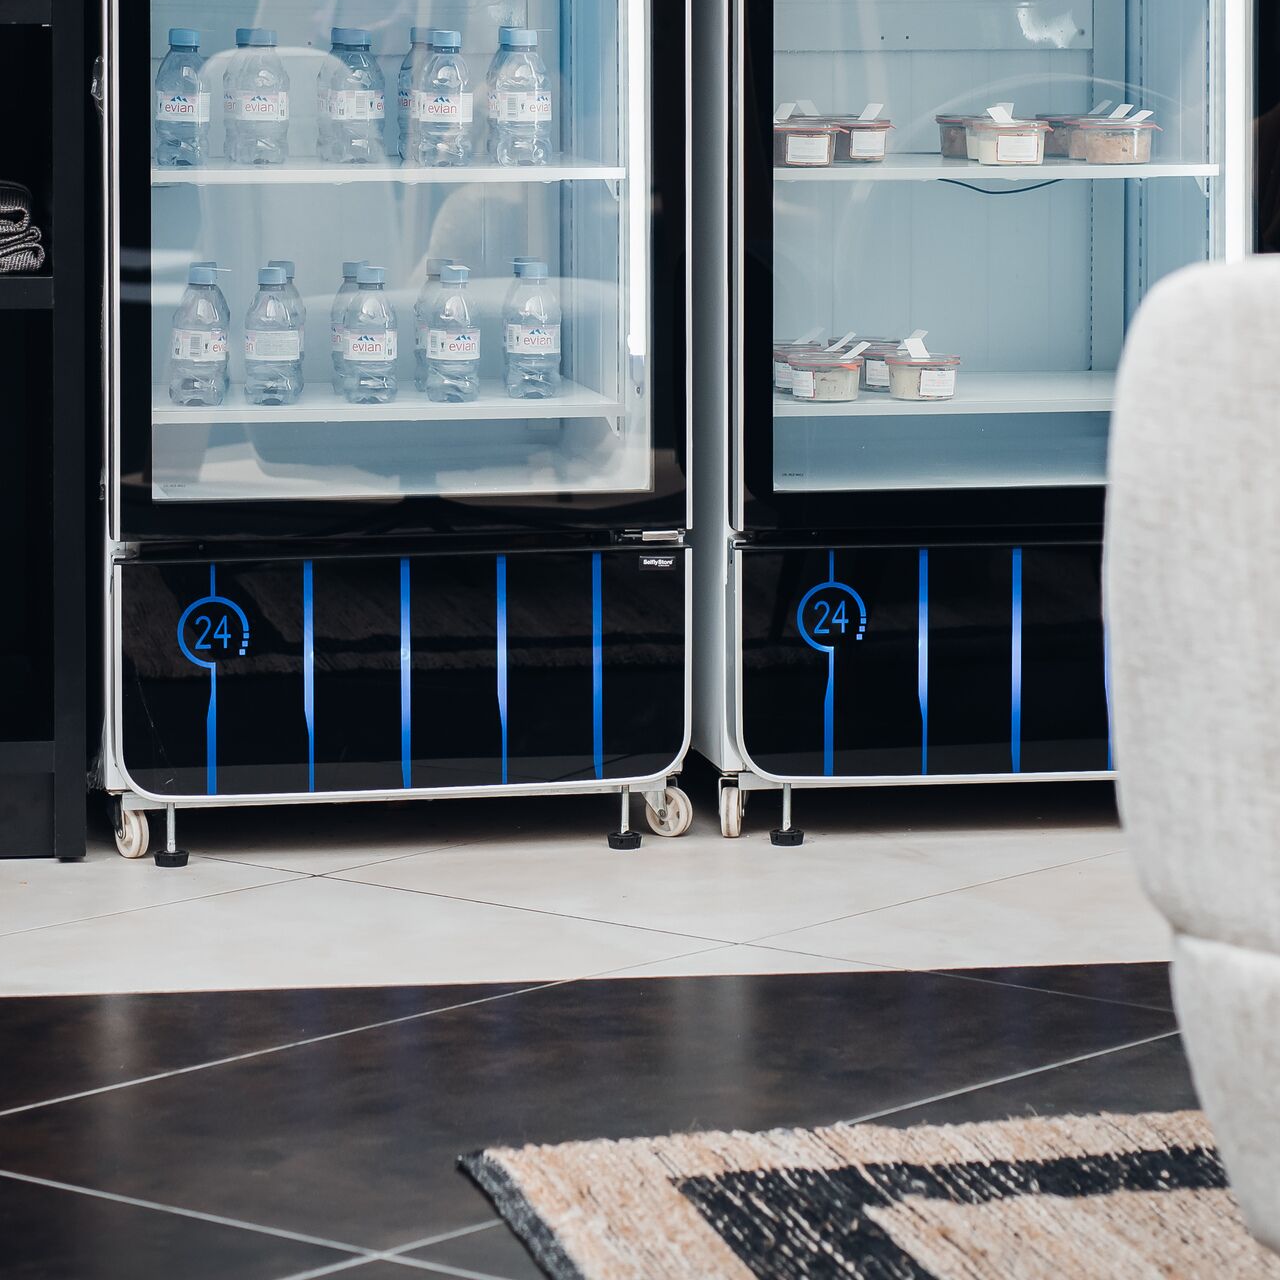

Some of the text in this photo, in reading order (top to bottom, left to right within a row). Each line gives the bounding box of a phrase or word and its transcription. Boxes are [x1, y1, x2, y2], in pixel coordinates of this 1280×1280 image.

[164, 102, 195, 113] evian
[245, 102, 274, 112] evian
[428, 104, 457, 114] evian
[352, 340, 382, 352] evian
[448, 340, 476, 352] evian
[523, 335, 552, 346] evian
[813, 600, 849, 634] 24
[194, 615, 232, 651] 24
